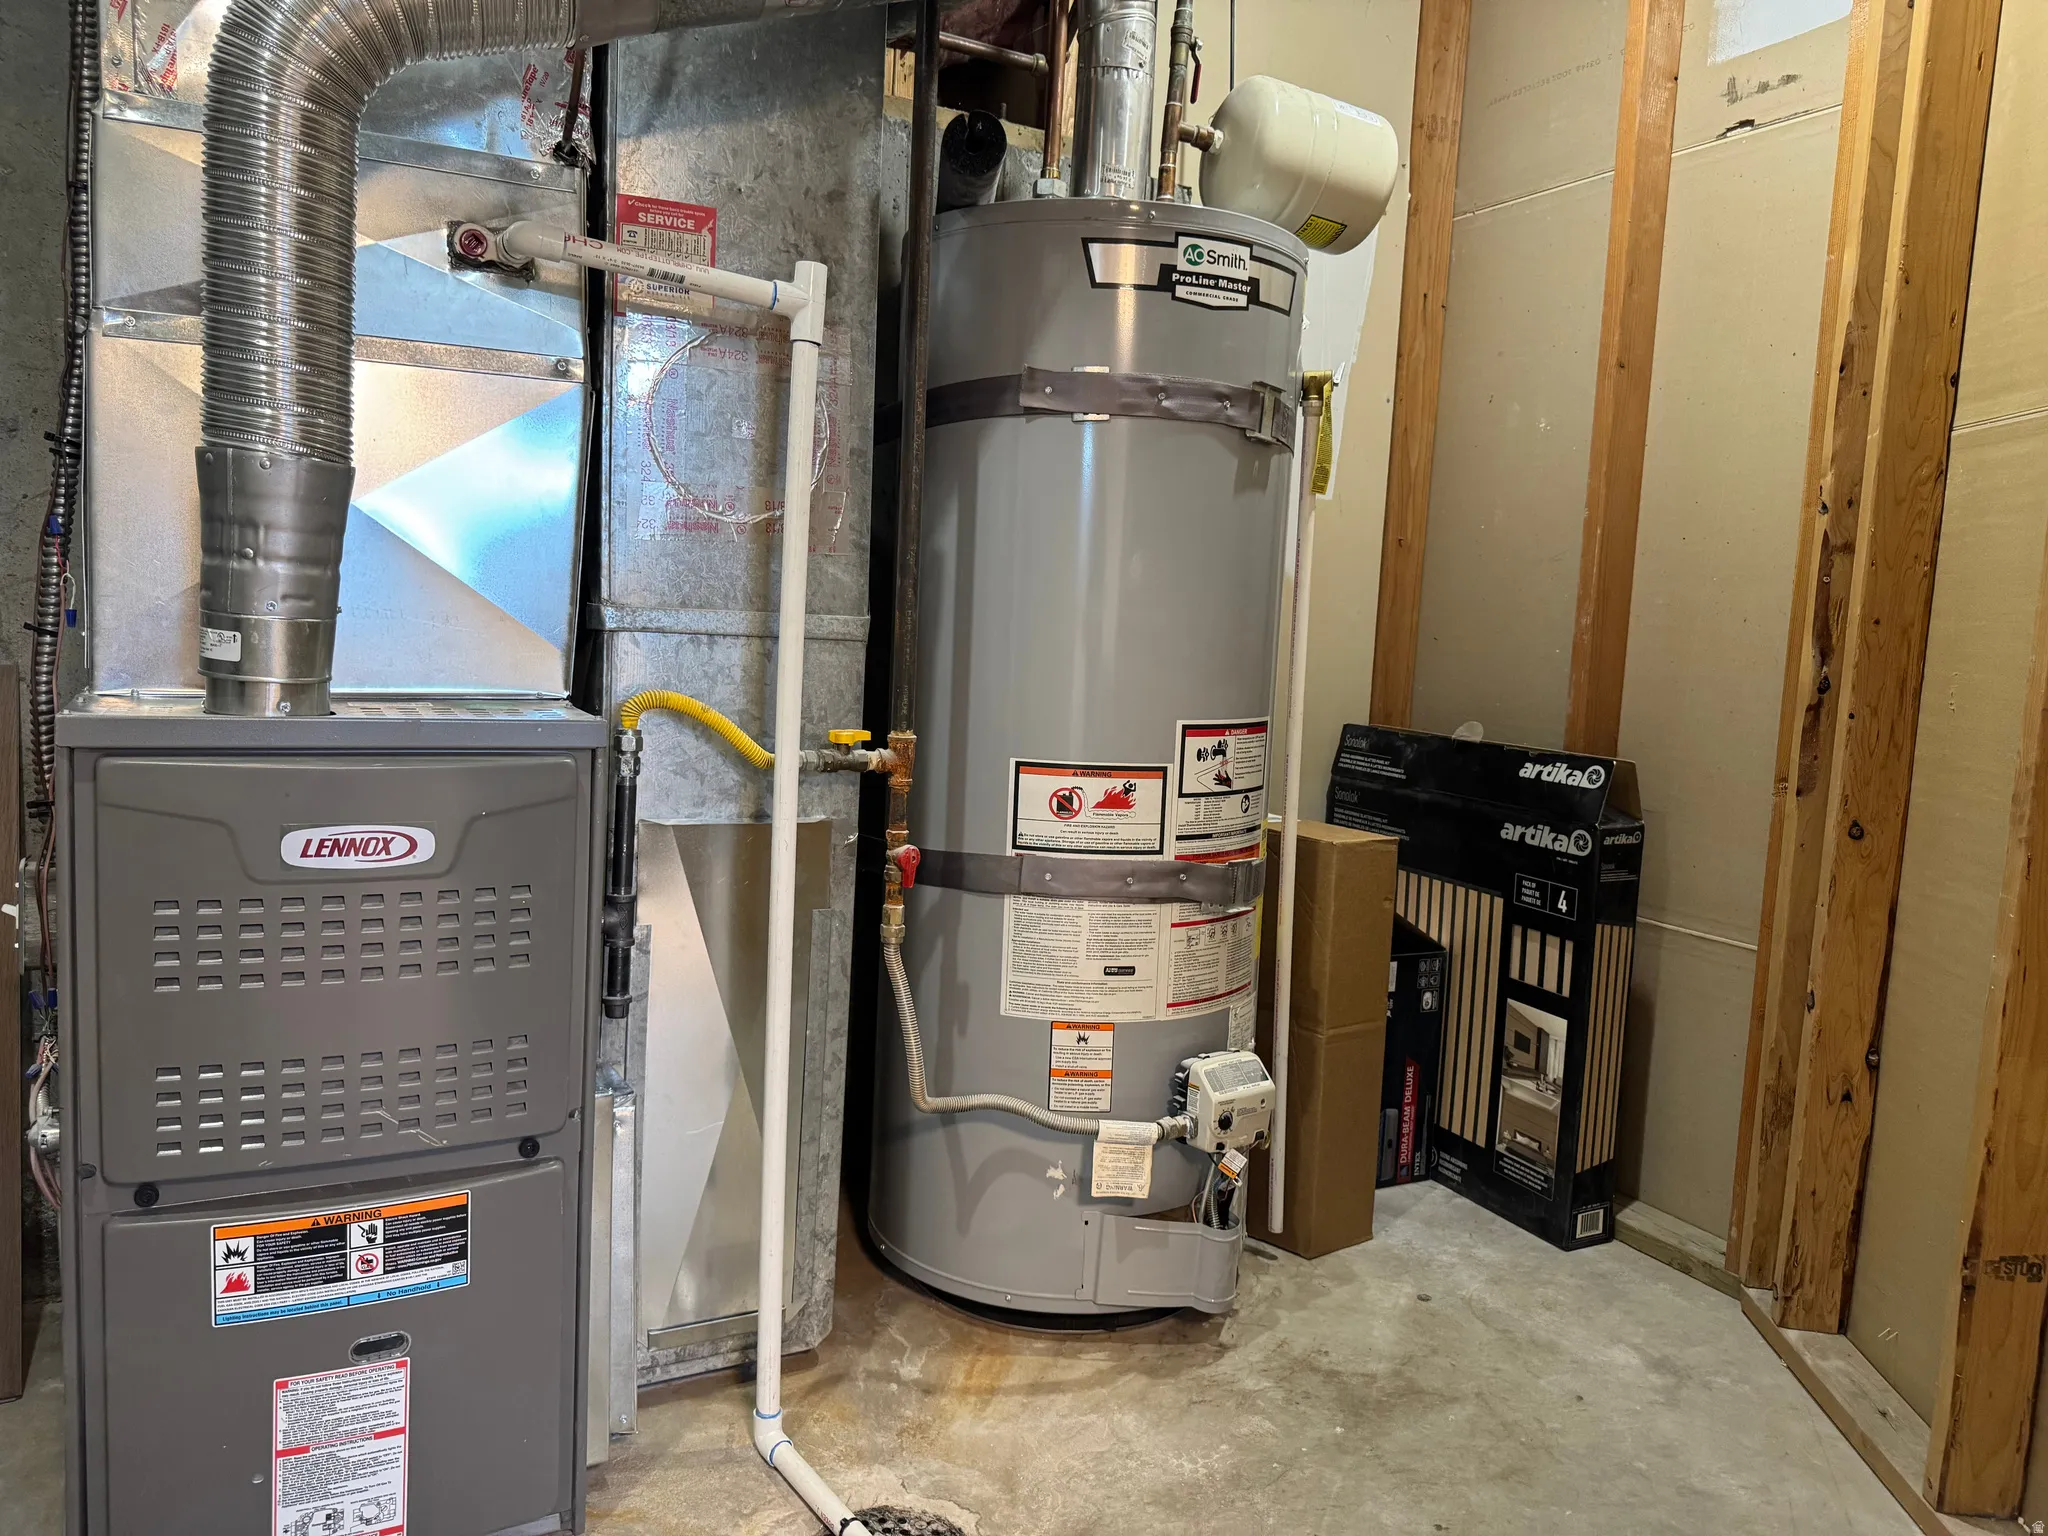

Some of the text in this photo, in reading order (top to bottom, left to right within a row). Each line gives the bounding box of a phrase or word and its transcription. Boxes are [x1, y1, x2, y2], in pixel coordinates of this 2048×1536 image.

[638, 212, 695, 230] SERVICE
[646, 283, 690, 295] SUPERIOR
[1172, 273, 1252, 293] ProLine Master
[1185, 290, 1221, 300] COMMERCIAL
[1079, 770, 1112, 778] WARNING
[1518, 761, 1584, 788] artika
[1500, 822, 1569, 853] artika
[1603, 833, 1634, 845] artika
[299, 836, 397, 859] LENNOX
[1557, 890, 1567, 913] 4
[1404, 1065, 1414, 1103] DELUXE
[1400, 1105, 1411, 1164] DURA-BEAM
[1413, 1151, 1421, 1176] INTEX
[323, 1209, 382, 1226] WARNING
[386, 1284, 431, 1297] No Handhold
[222, 1314, 241, 1322] Lighting
[242, 1310, 268, 1319] instructions
[329, 1300, 343, 1308] panel.
[316, 1375, 334, 1383] SAFETY
[349, 1369, 367, 1377] BEFORE
[369, 1364, 394, 1374] OPERATING
[311, 1436, 373, 1452] OPERATING INSTRUCTIONS
